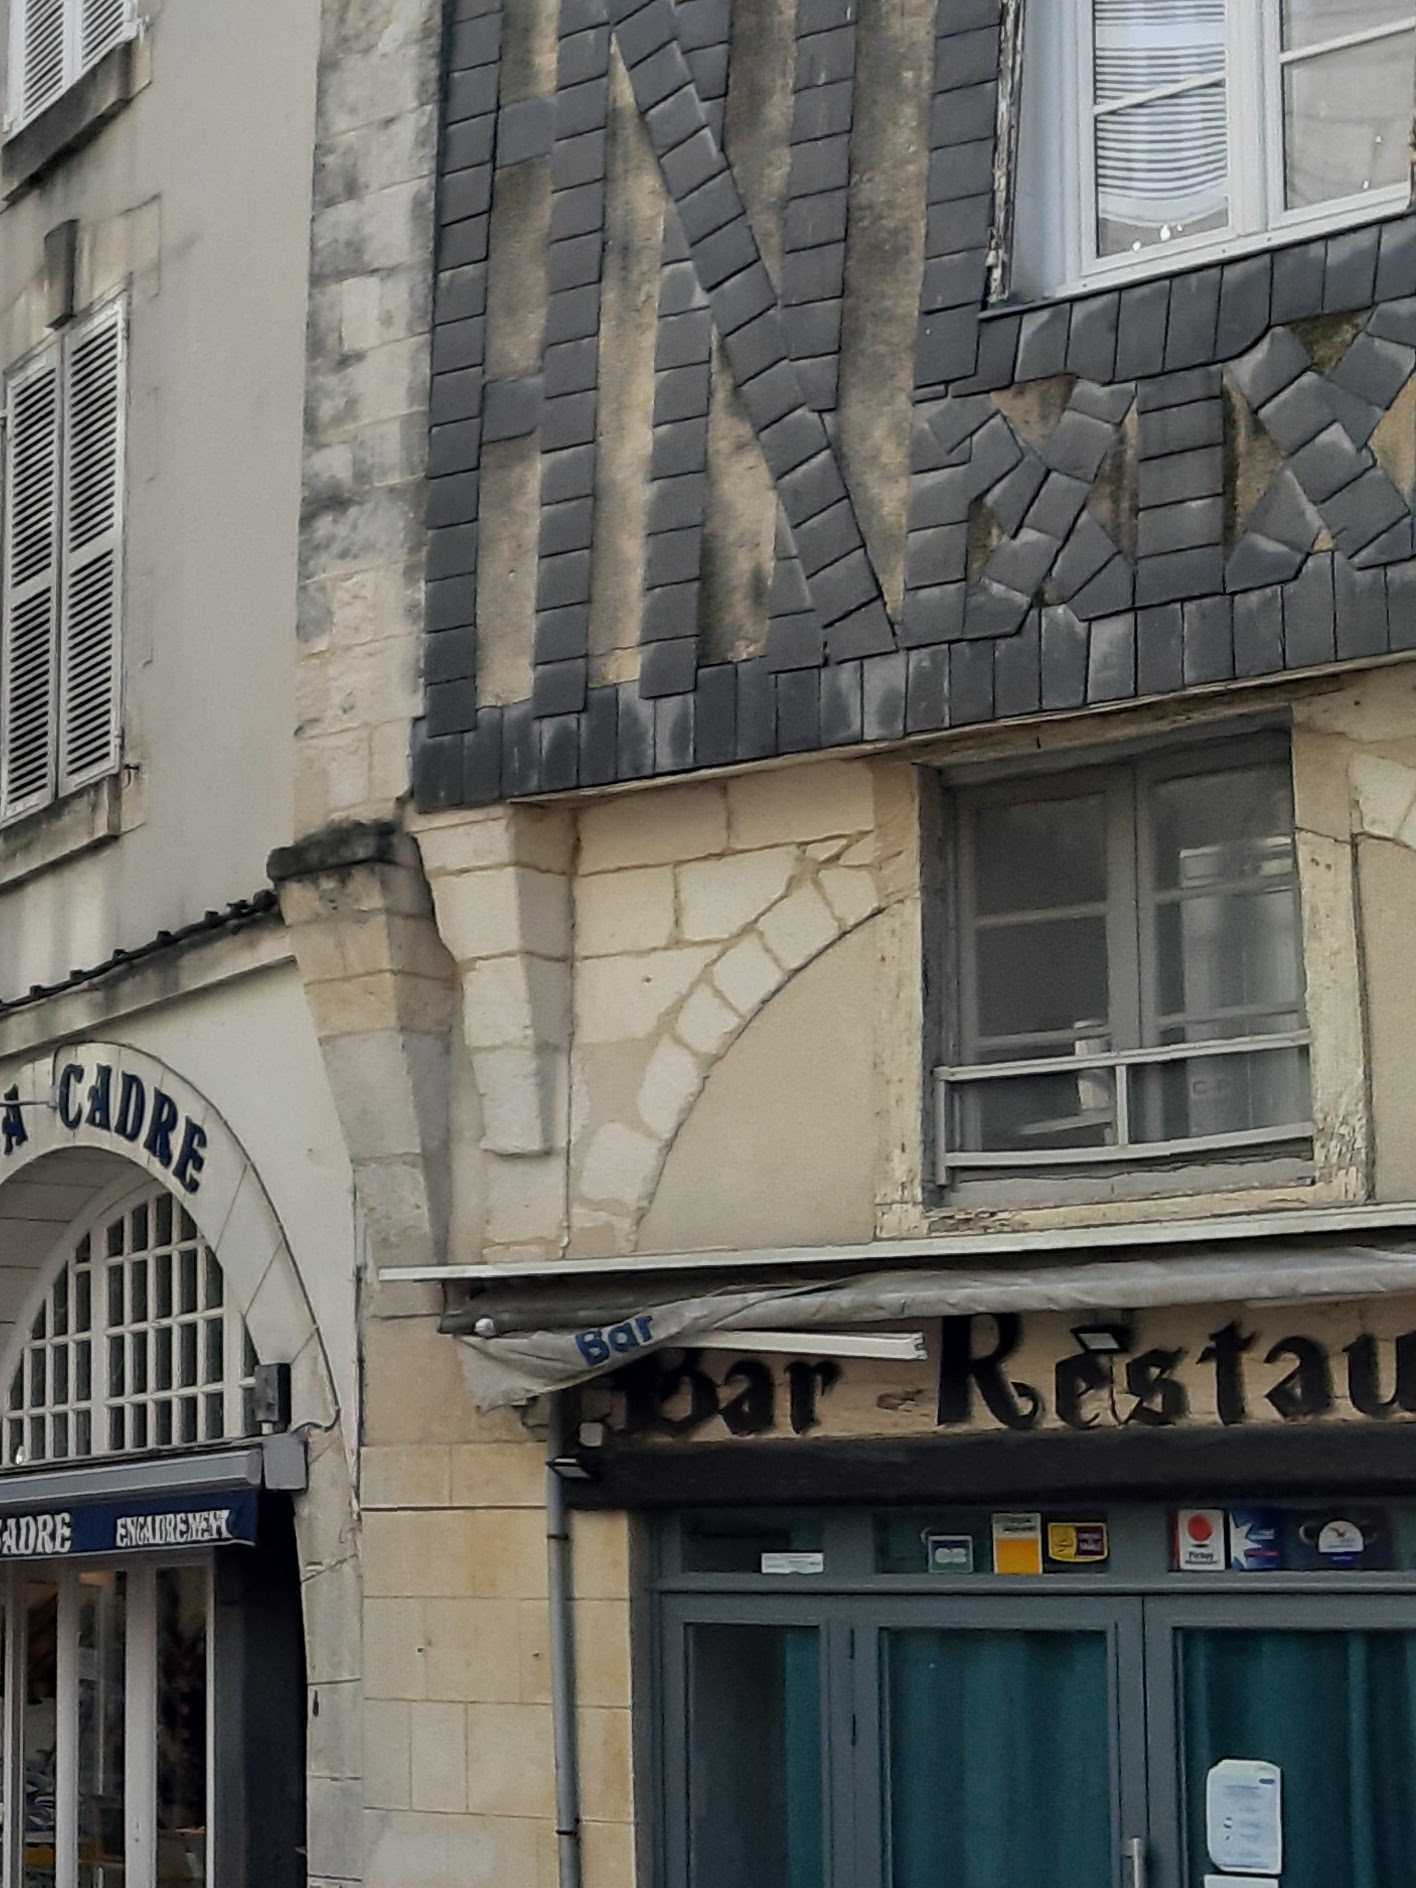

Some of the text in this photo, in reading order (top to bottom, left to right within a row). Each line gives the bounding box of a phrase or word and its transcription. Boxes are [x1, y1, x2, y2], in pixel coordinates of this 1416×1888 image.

[58, 1063, 208, 1194] CADRE
[576, 1315, 654, 1367] Bar
[620, 1352, 844, 1437] Bar
